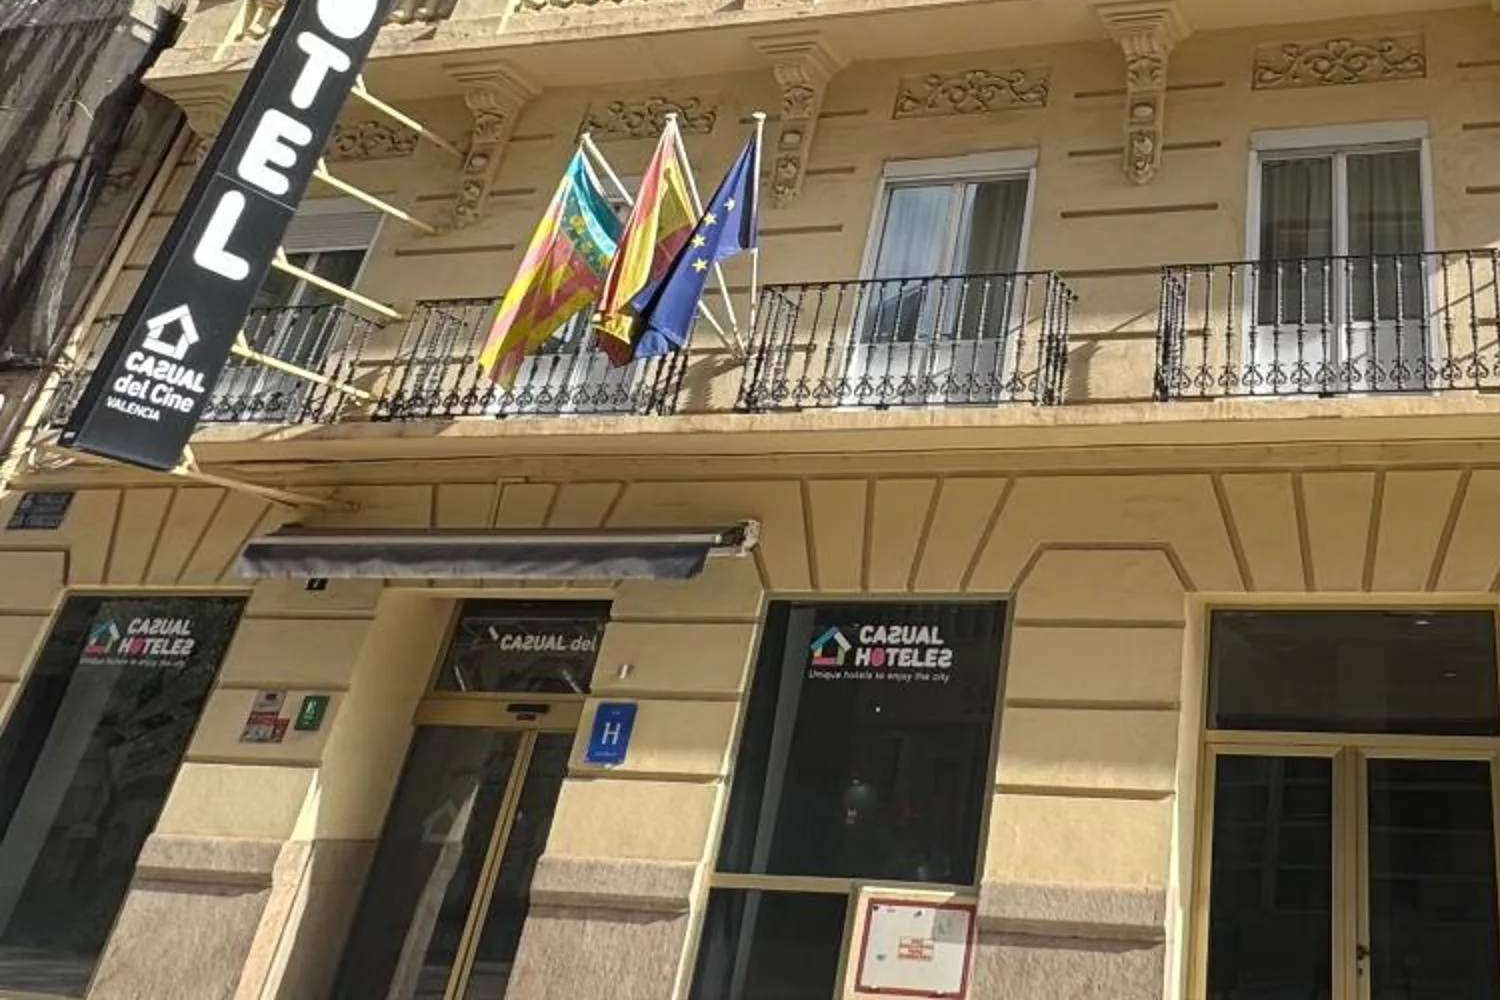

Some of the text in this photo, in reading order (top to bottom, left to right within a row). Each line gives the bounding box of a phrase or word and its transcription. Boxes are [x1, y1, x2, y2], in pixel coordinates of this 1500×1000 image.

[125, 350, 205, 393] CASUAL
[113, 373, 194, 413] del Cine
[106, 396, 160, 421] VALENCIA
[127, 617, 191, 635] CASUAL
[859, 624, 944, 645] CASUAL
[500, 633, 598, 652] CASUAL del
[601, 722, 621, 745] H
